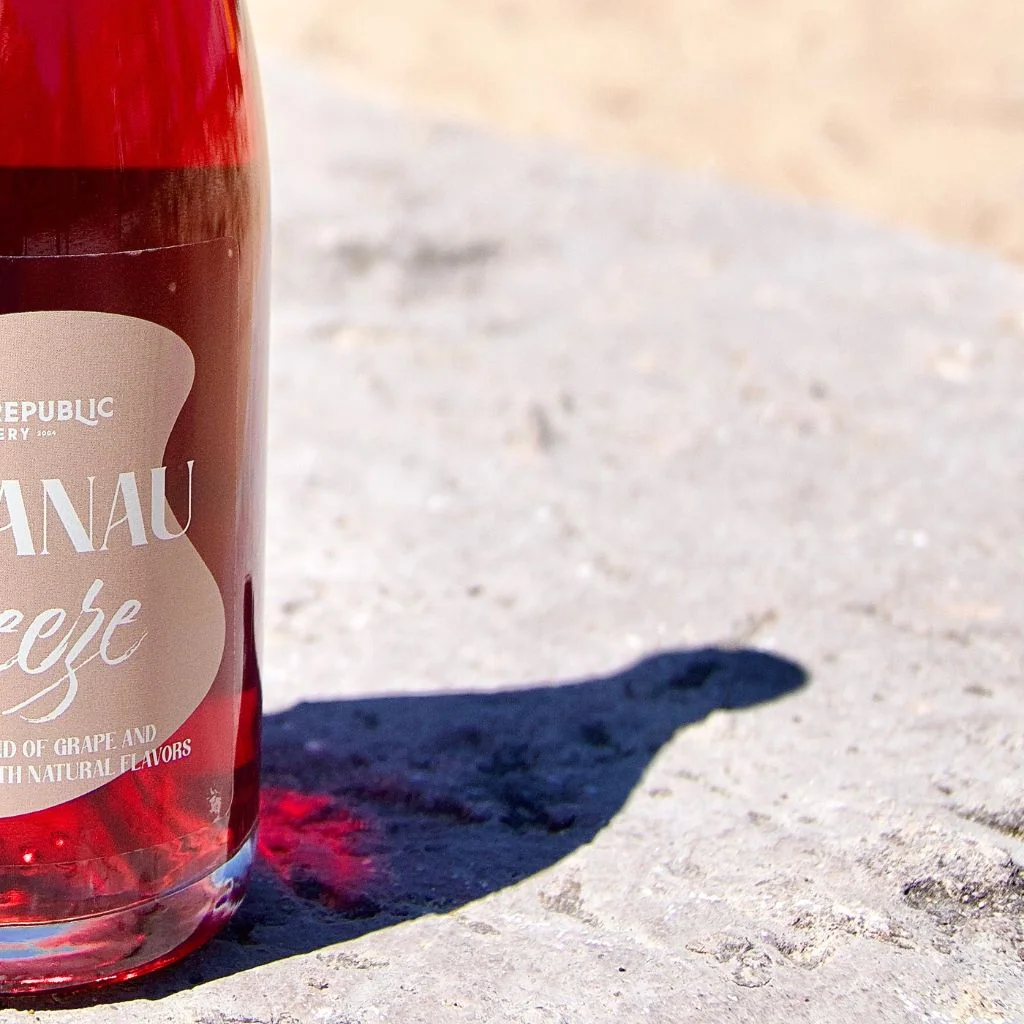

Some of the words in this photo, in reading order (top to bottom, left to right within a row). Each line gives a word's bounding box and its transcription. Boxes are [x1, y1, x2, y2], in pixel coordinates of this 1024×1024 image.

[22, 740, 48, 758] OF
[54, 732, 117, 756] GRAPE
[122, 724, 157, 749] AND
[28, 758, 115, 783] NATURAL
[120, 738, 192, 775] FLAVORS
